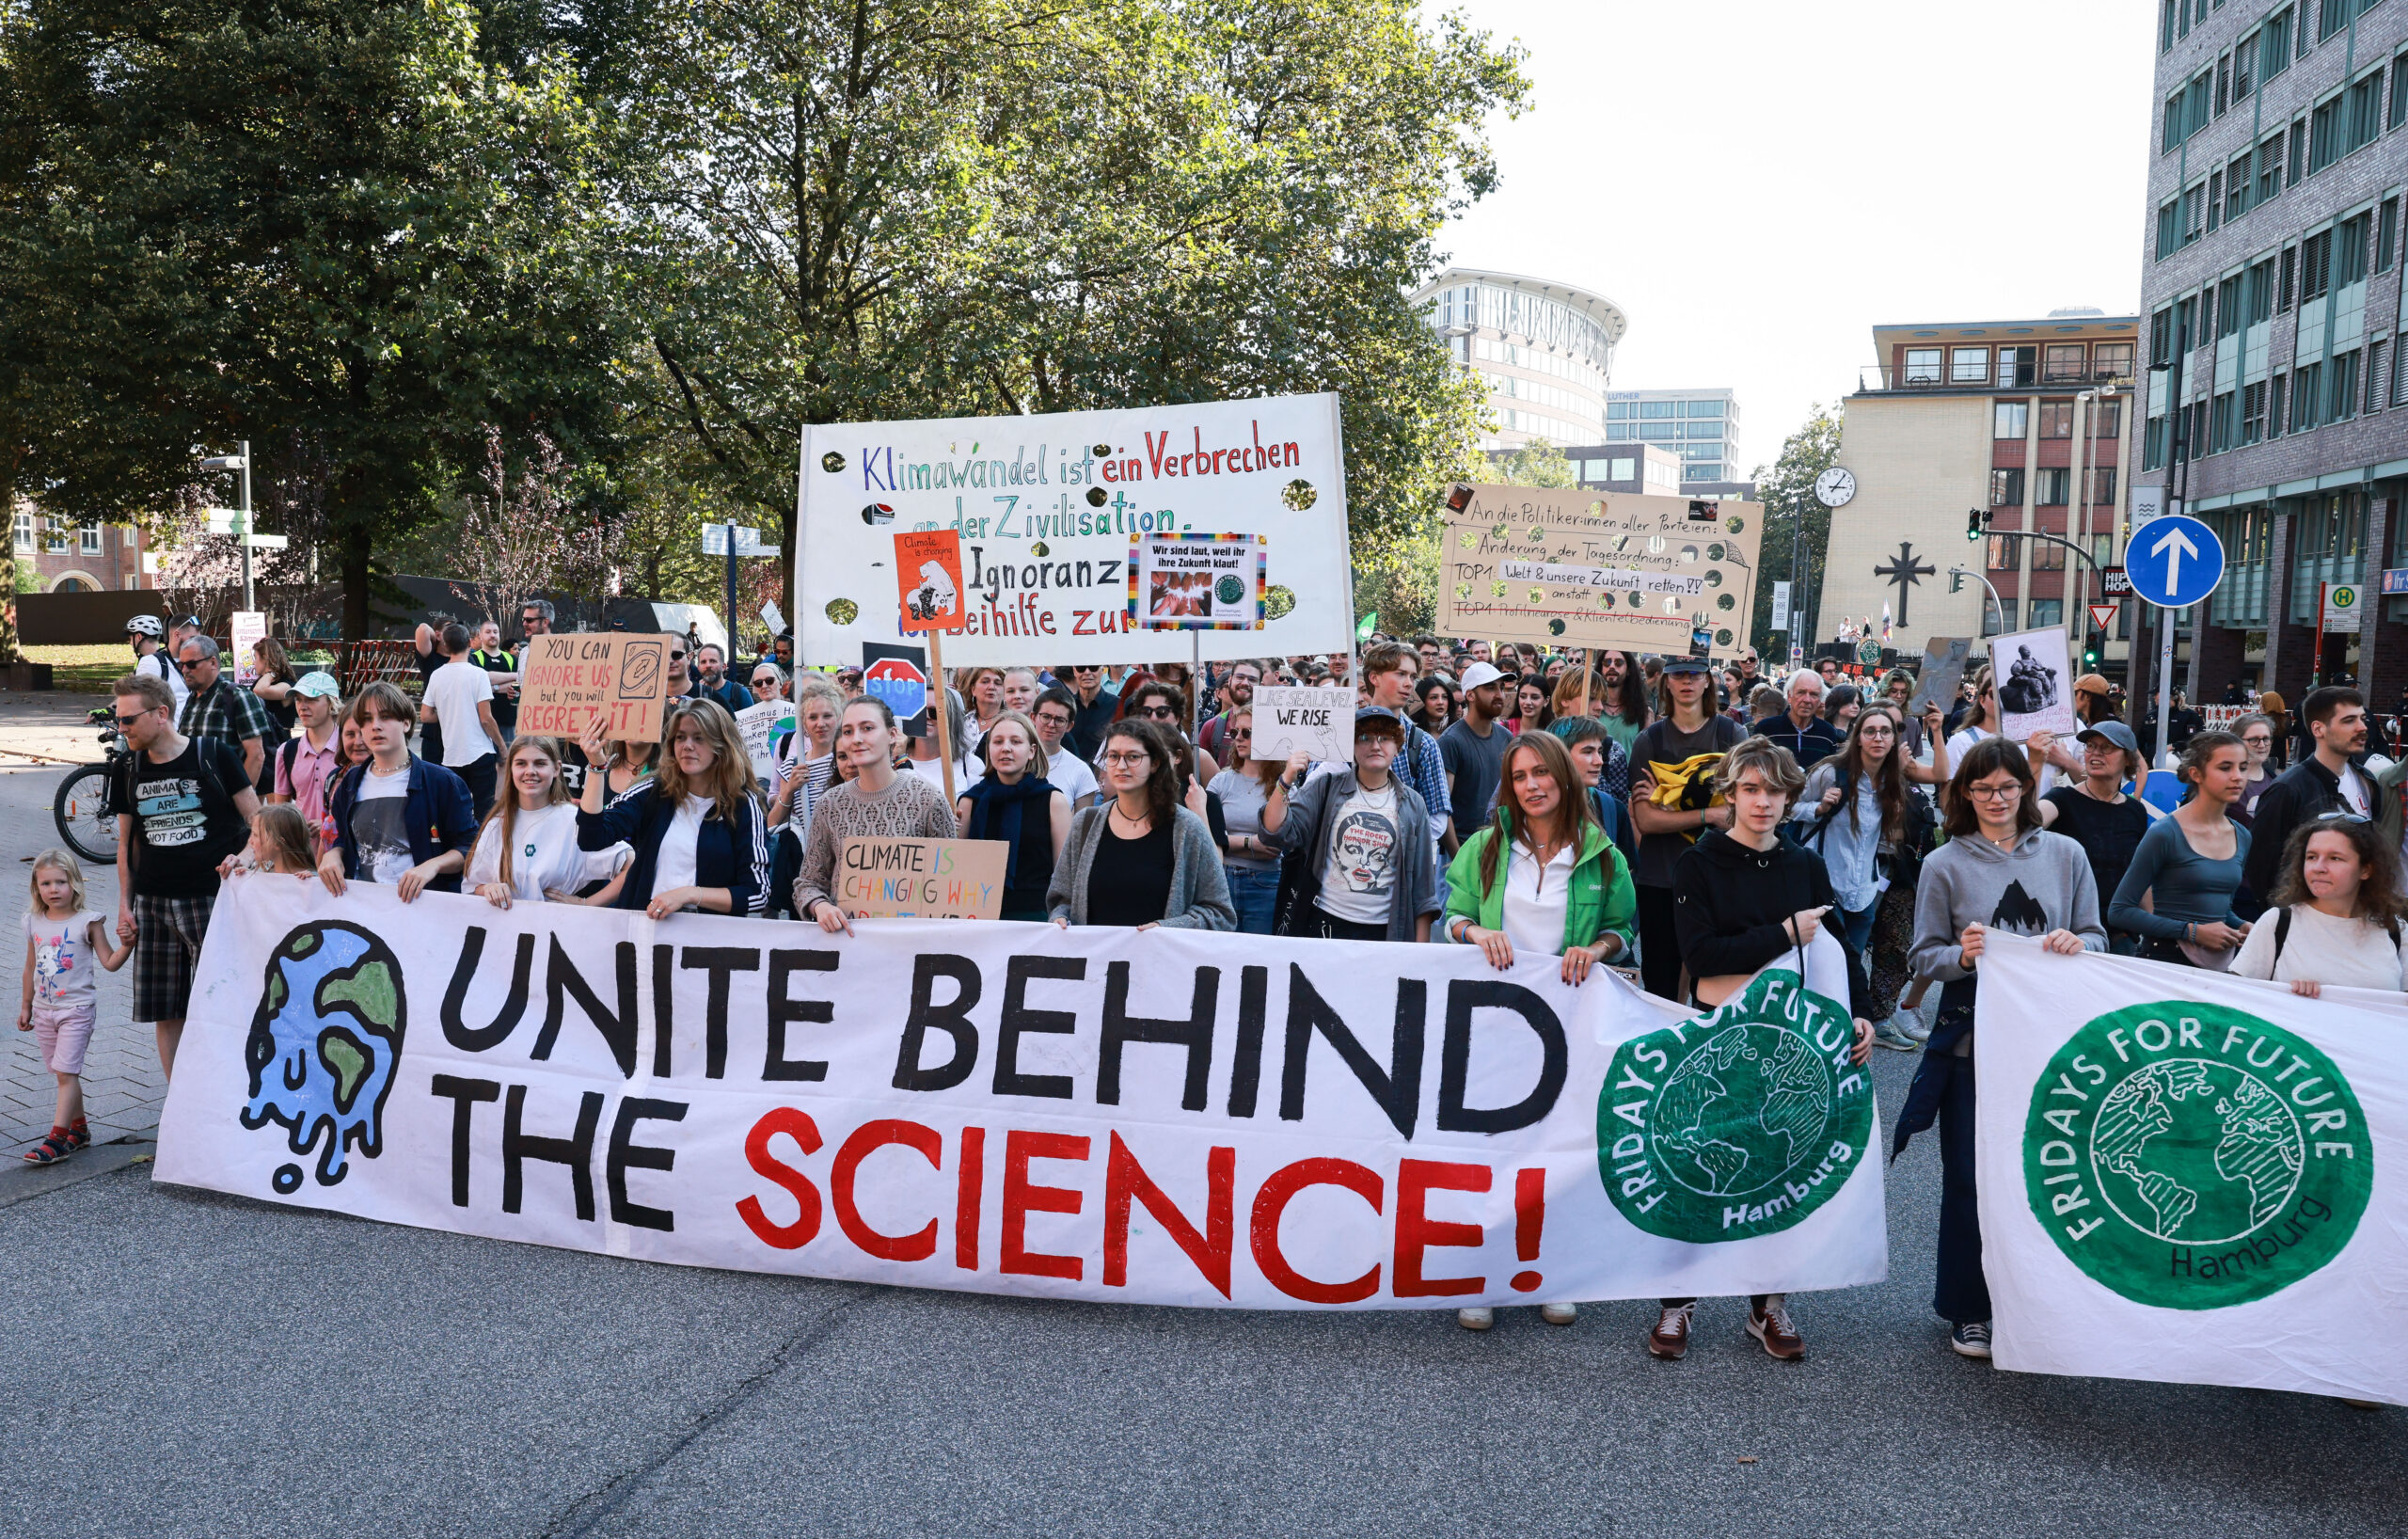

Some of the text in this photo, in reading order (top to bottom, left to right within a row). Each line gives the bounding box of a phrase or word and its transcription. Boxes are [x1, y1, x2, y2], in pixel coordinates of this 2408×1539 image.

[1607, 391, 1640, 401] LUTHER
[863, 420, 1300, 490] Klimawandel ist ein Verbrechen
[950, 496, 990, 539] der
[993, 490, 1192, 539] Zivilisation.
[1470, 500, 1718, 534] An die Politiker:innen aller Parteien:
[904, 534, 938, 548] Climate
[915, 547, 953, 561] is changing
[1152, 545, 1245, 557] Wir sind laut, weil ihr
[1479, 532, 1679, 572] Änderung der Tagesordnung:
[1158, 558, 1239, 569] ihre Zukunft klaut!
[968, 547, 1122, 602] Ignoranz
[1505, 565, 1531, 579] Welt
[1535, 566, 1544, 580] &
[1546, 572, 1586, 584] unsere
[1592, 571, 1640, 589] Zukunft
[2105, 572, 2127, 581] HIP
[2394, 572, 2404, 590] Ihr
[1552, 588, 1592, 600] anstatt
[2105, 581, 2131, 591] HOP
[2338, 592, 2349, 603] H
[546, 639, 610, 660] YOU CAN
[529, 664, 613, 689] IGNORE US
[870, 671, 919, 695] STOP
[540, 689, 605, 706] but you will
[1256, 690, 1286, 706] LIKE
[521, 706, 599, 734] REGRET
[752, 721, 765, 730] ans
[1276, 708, 1331, 726] WE RISE
[157, 799, 179, 811] ARE
[150, 815, 194, 828] FRIENDS
[149, 829, 198, 843] NOT FOOD
[1343, 834, 1391, 849] HORROR SHOW
[1350, 827, 1389, 843] THE ROCKY
[846, 844, 955, 875] CLIMATE IS
[846, 876, 994, 909] CHANGING WHY
[439, 925, 1569, 1142] UNITE BEHIND
[1612, 1041, 1668, 1214] FRIDAYS
[1760, 980, 1862, 1098] FUTURE
[2040, 1017, 2354, 1242] FRIDAYS FOR FUTURE
[431, 1072, 1547, 1304] THE SCIENCE!
[1722, 1139, 1852, 1230] Hamburg
[2171, 1195, 2333, 1279] Hamburg
